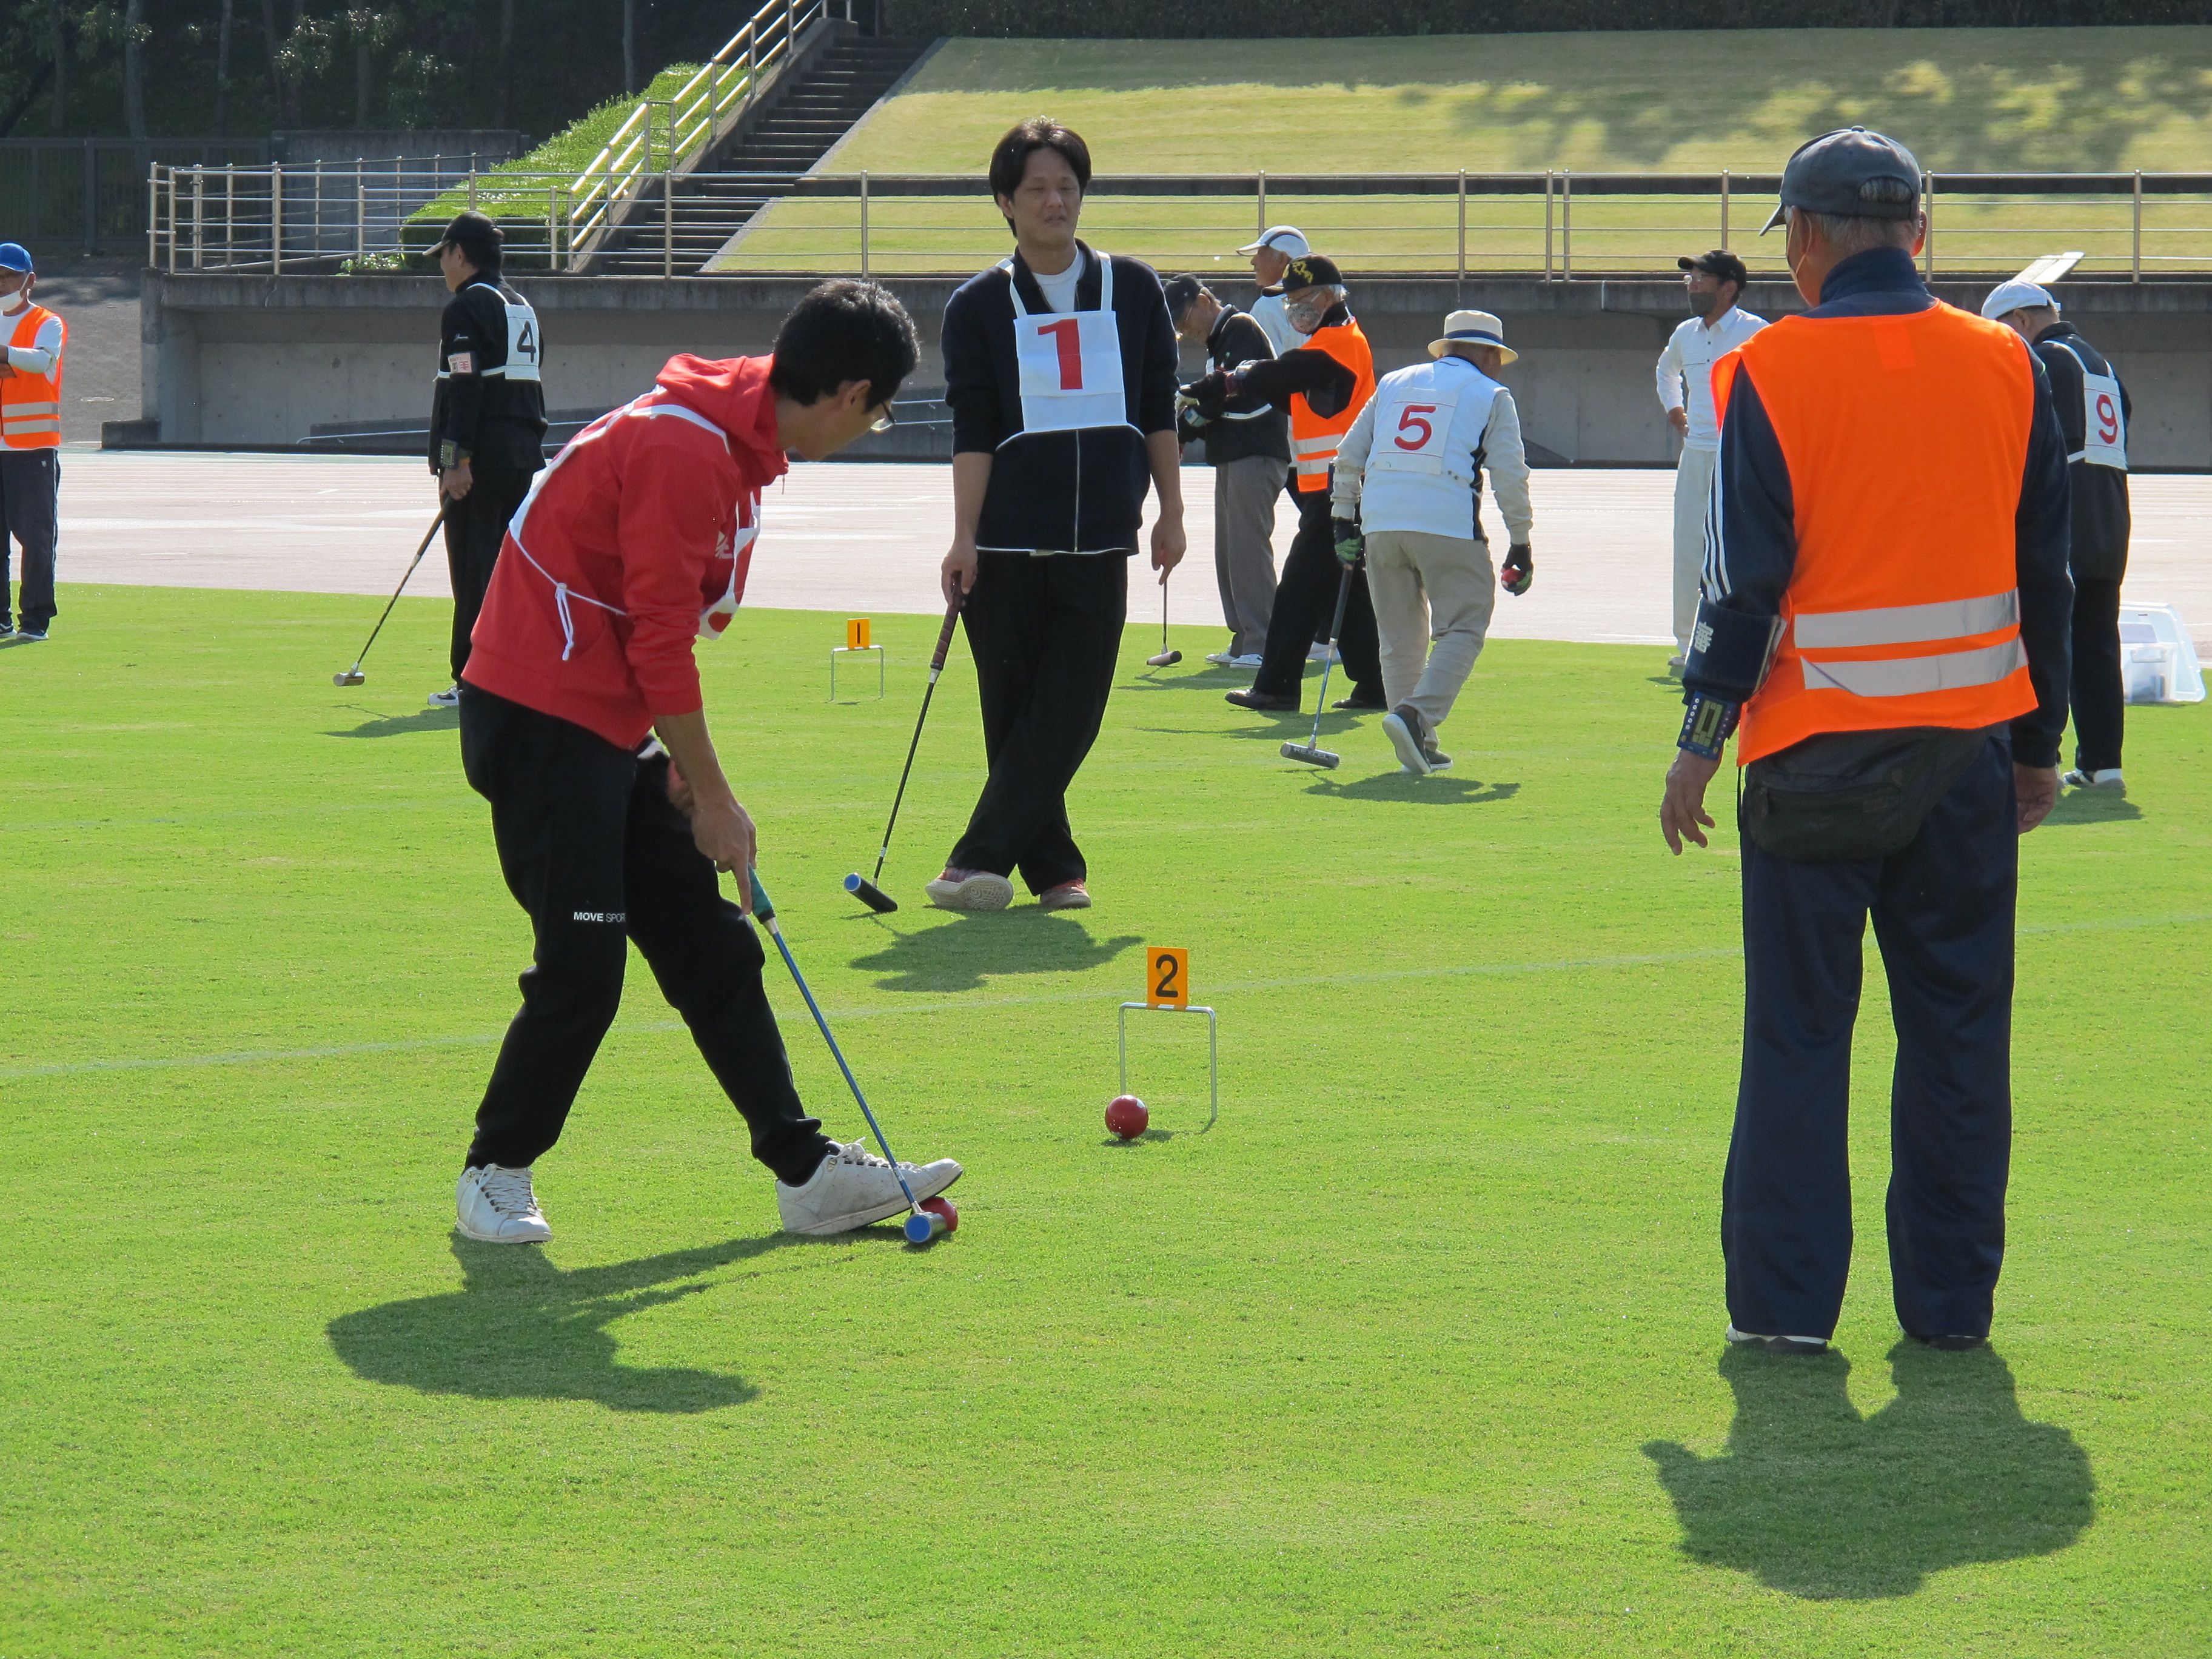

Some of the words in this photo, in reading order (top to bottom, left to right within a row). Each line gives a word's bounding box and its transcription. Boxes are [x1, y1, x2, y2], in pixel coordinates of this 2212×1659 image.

[517, 320, 536, 363] 4
[1037, 318, 1083, 390] 1
[1395, 405, 1436, 451] 5
[2096, 394, 2118, 444] 9
[574, 912, 603, 921] MOVE
[1155, 954, 1179, 998] 2
